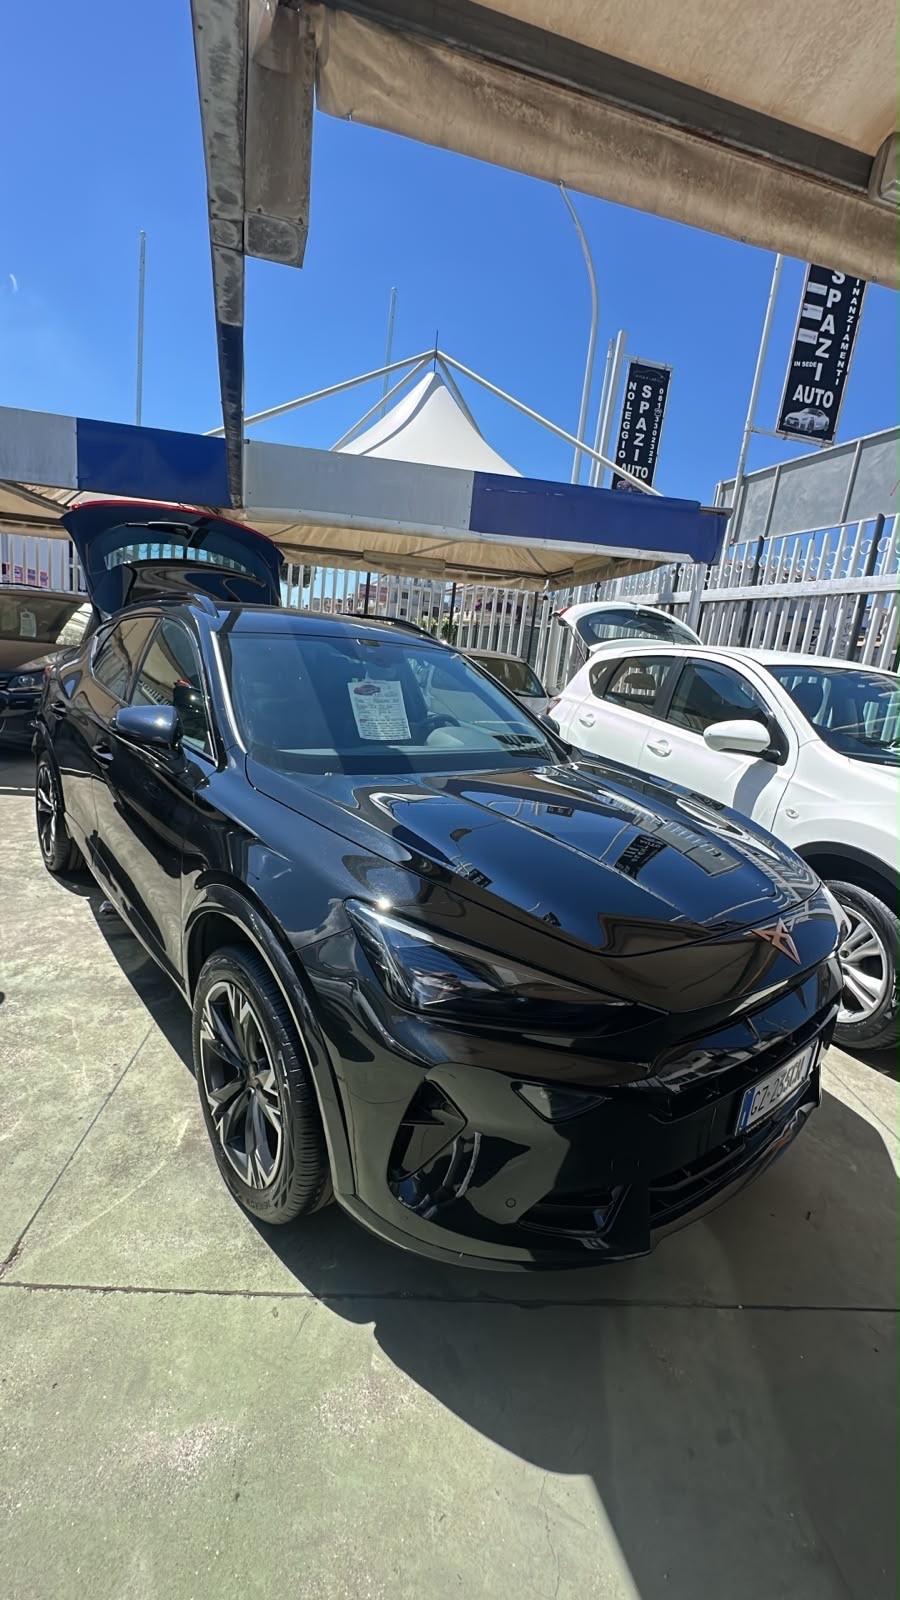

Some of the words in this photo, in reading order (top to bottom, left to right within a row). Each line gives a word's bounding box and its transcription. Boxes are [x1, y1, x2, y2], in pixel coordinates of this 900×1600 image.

[835, 279, 860, 386] INANZIAMENTI
[618, 381, 637, 459] NOLEGGIO
[633, 384, 652, 462] SPAZI
[792, 384, 834, 409] AUTO
[621, 463, 649, 479] AUTO
